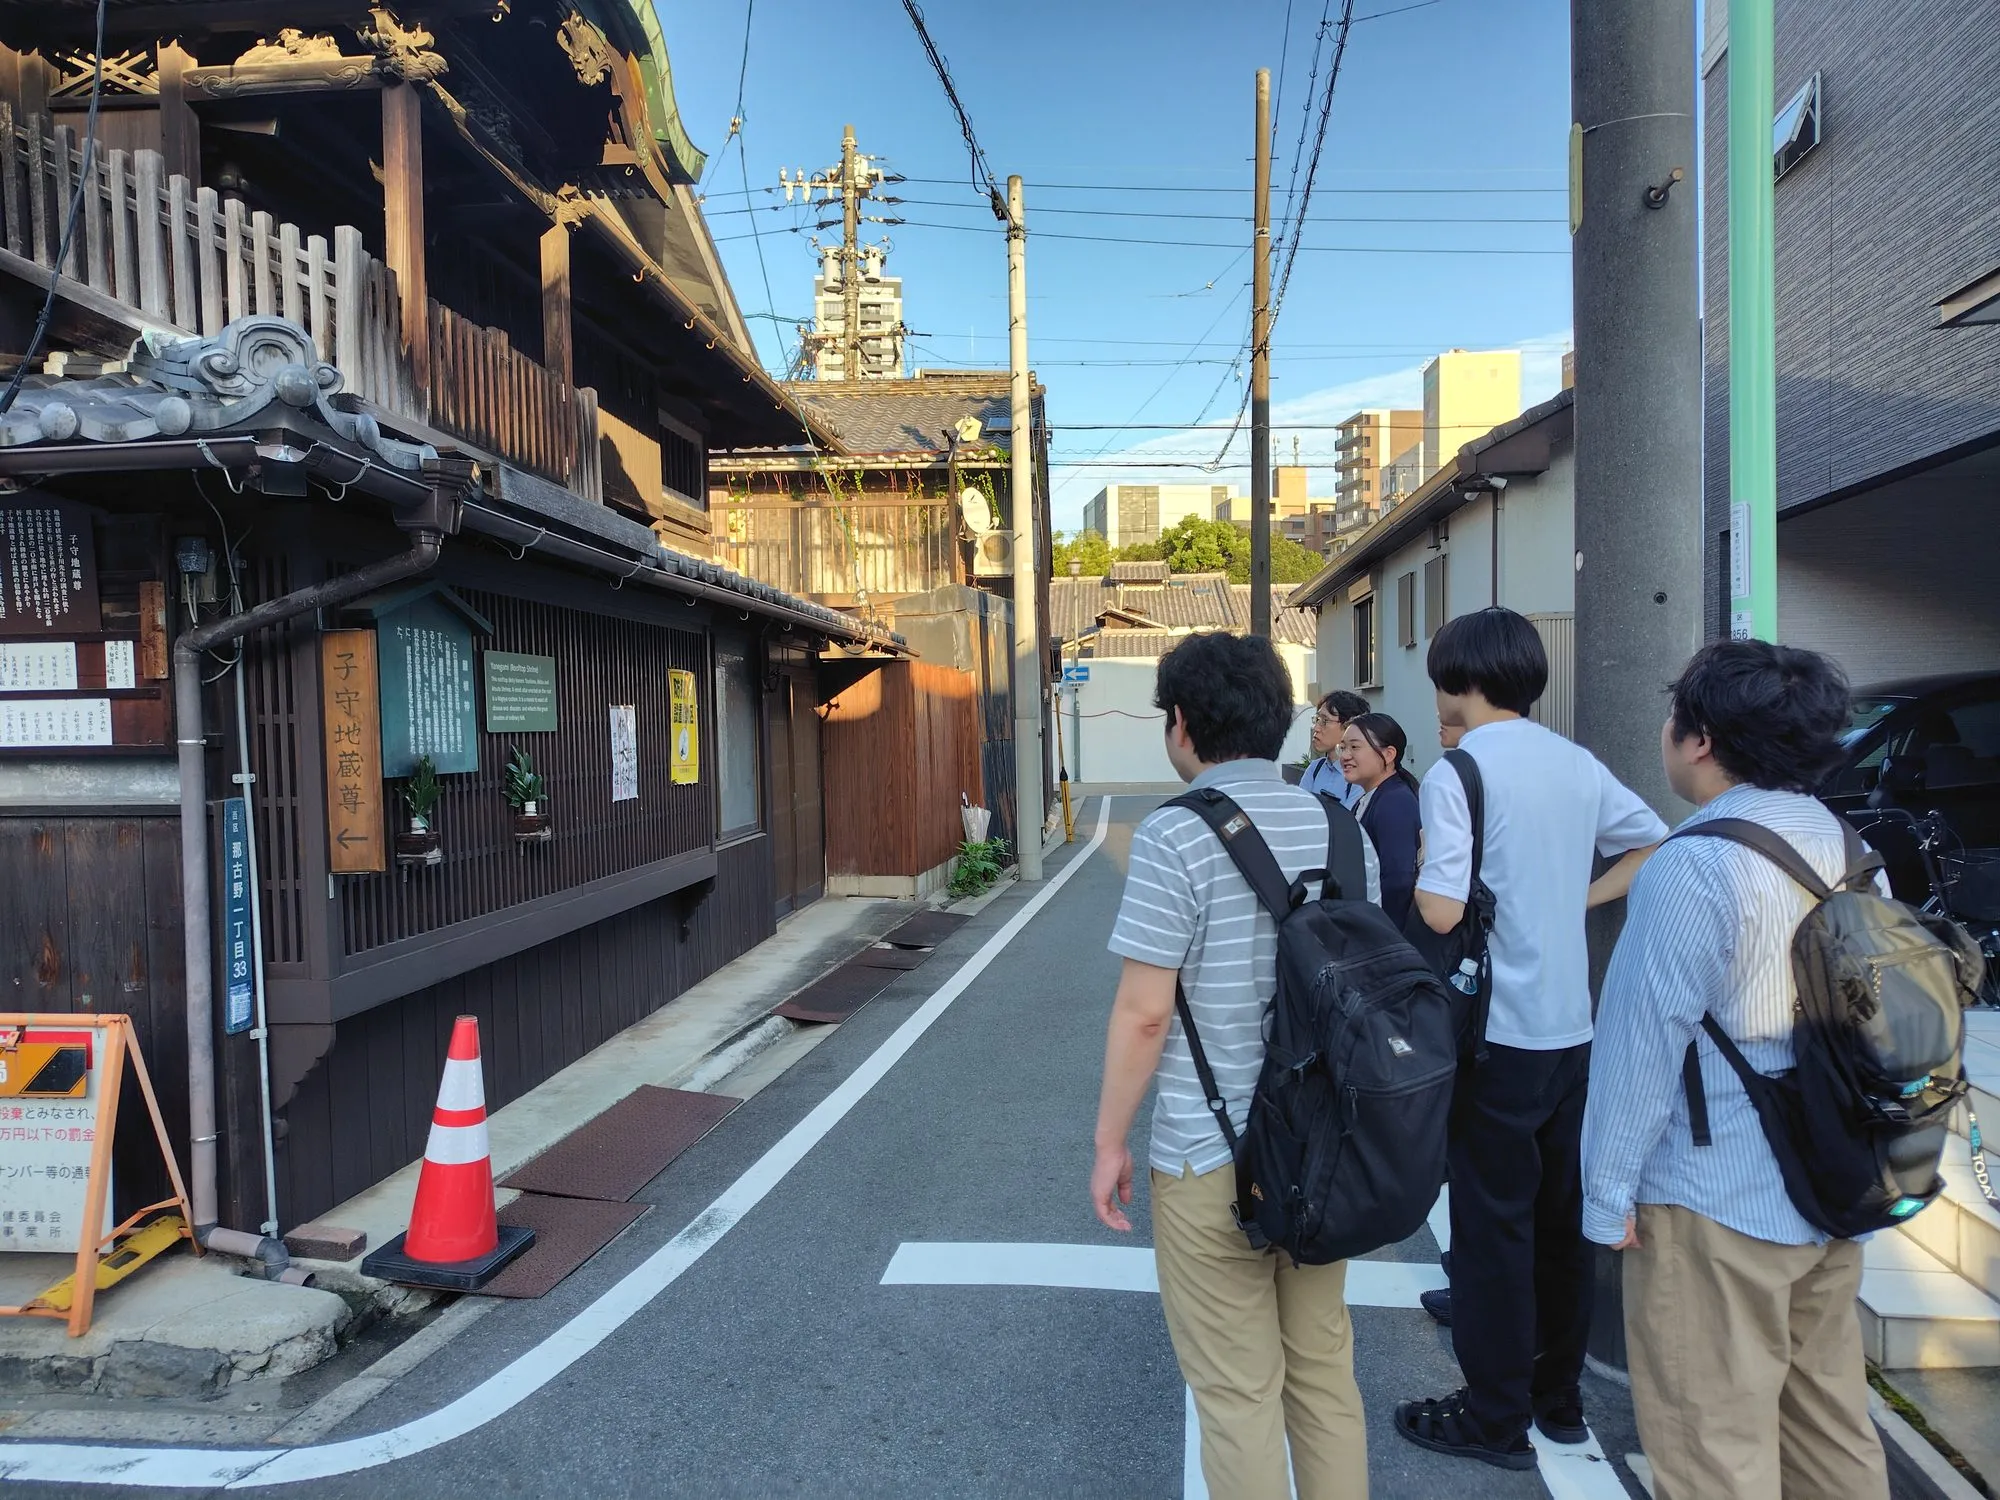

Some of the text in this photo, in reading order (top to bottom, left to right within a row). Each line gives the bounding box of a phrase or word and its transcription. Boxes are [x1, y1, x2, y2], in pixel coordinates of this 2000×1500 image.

[68, 534, 82, 591] 子守地蔵尊
[333, 653, 366, 815] 子守地蔵尊
[1972, 1153, 1999, 1200] TODAY
